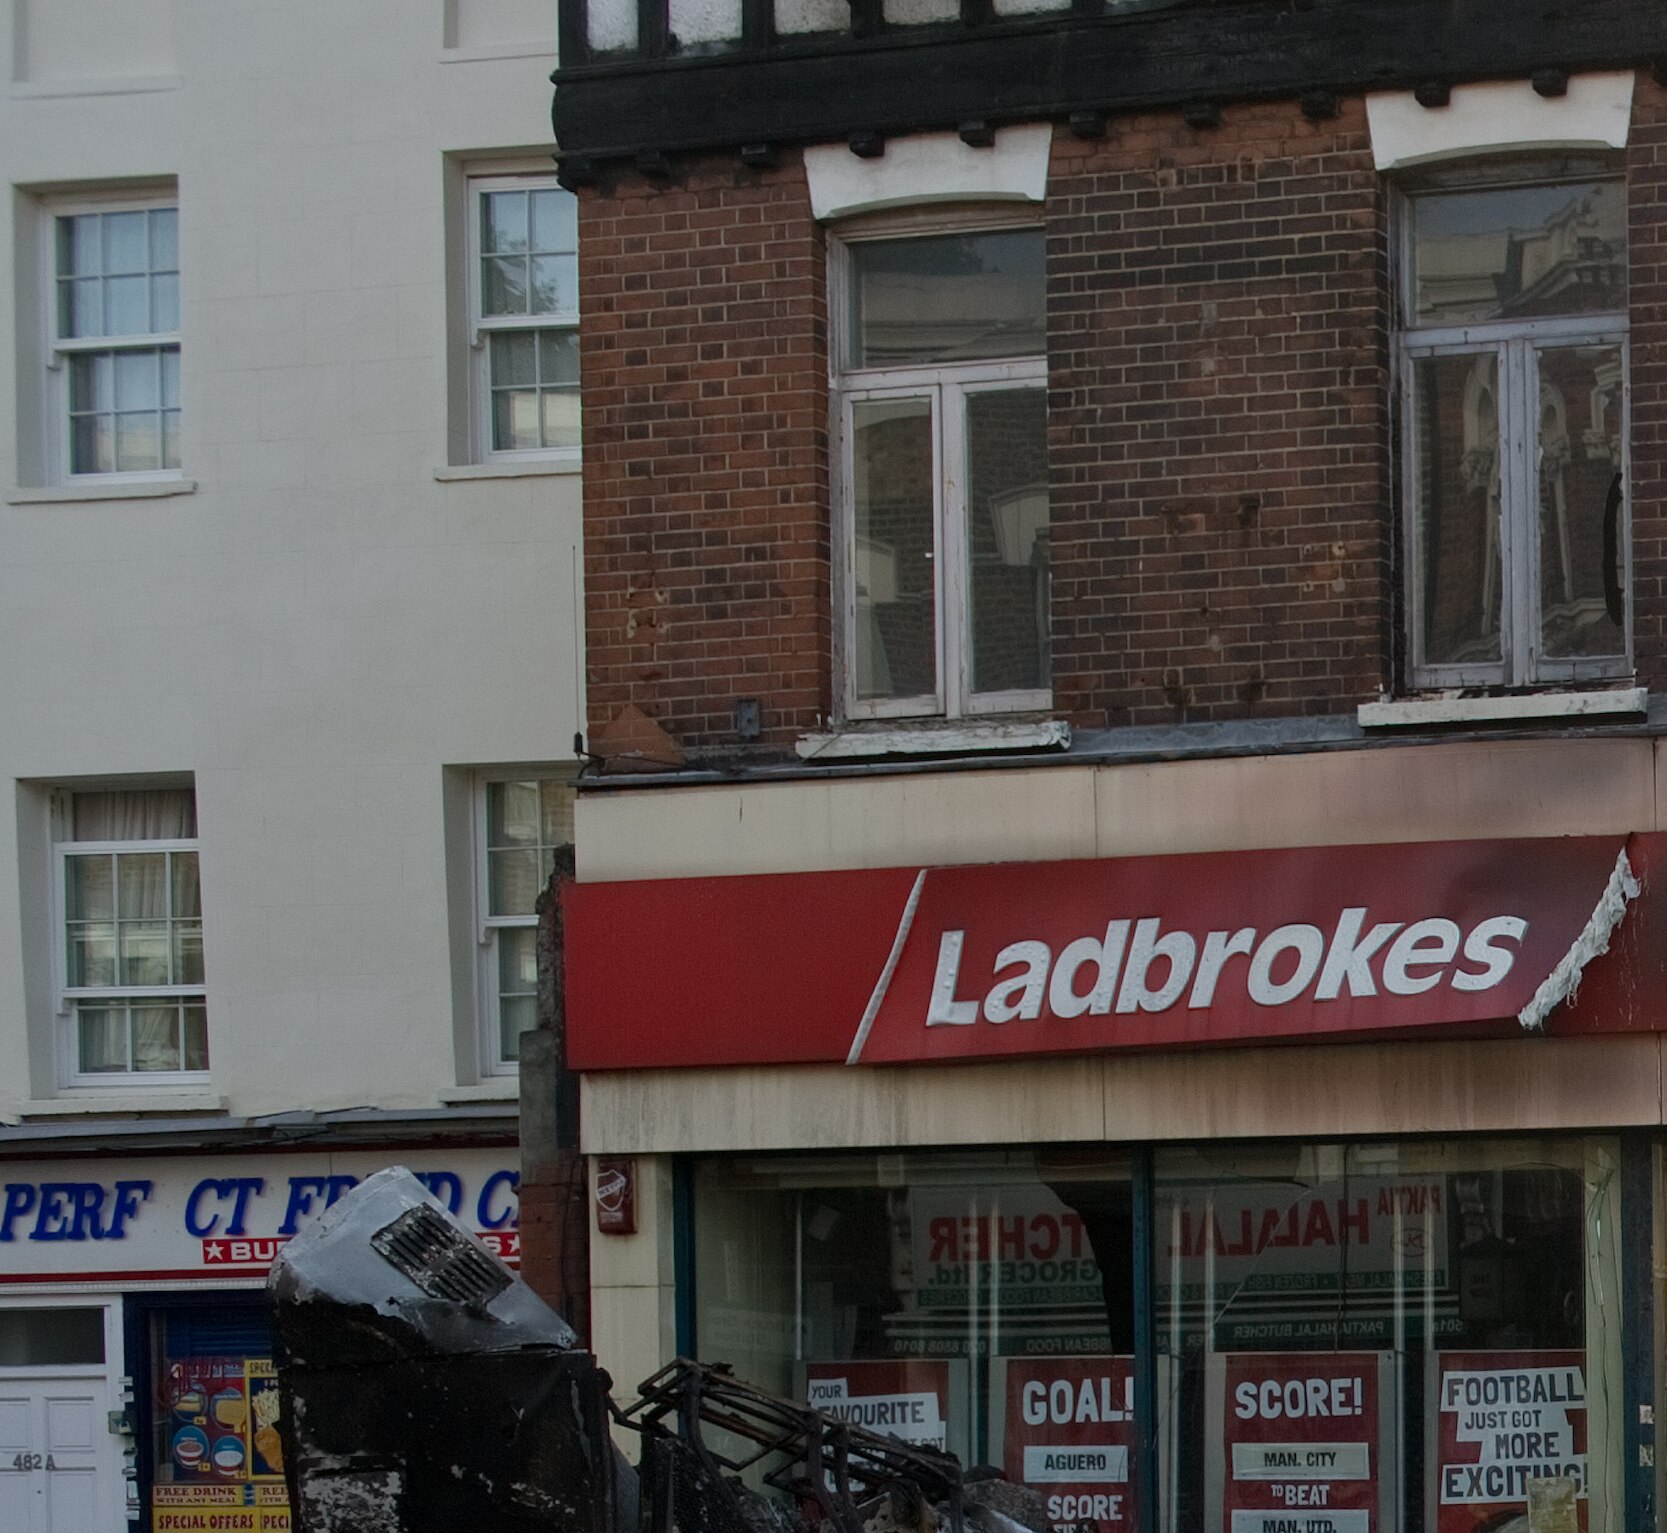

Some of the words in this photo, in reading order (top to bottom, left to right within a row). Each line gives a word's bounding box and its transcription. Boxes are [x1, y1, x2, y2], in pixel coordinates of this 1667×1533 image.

[926, 906, 1529, 1027] Ladbrokes
[811, 1384, 842, 1399] YOUR
[1233, 1376, 1364, 1419] SCORE!
[1446, 1373, 1585, 1406] FOOTBALL
[1022, 1375, 1135, 1426] GOAL!
[1464, 1410, 1508, 1430] JUST
[1511, 1409, 1542, 1428] GOT
[1495, 1431, 1560, 1460] MORE
[1044, 1454, 1107, 1470] AGUERO
[1263, 1451, 1302, 1467] MAN.
[1306, 1451, 1337, 1467] CITY
[156, 1487, 189, 1496] FREE
[193, 1487, 237, 1496] DRINK
[1270, 1484, 1284, 1497] TO
[1284, 1484, 1331, 1506] BEAT
[1046, 1494, 1124, 1521] SCORE
[158, 1514, 206, 1530] SPECIAL
[209, 1513, 254, 1529] OFFERS
[263, 1514, 289, 1529] PECI
